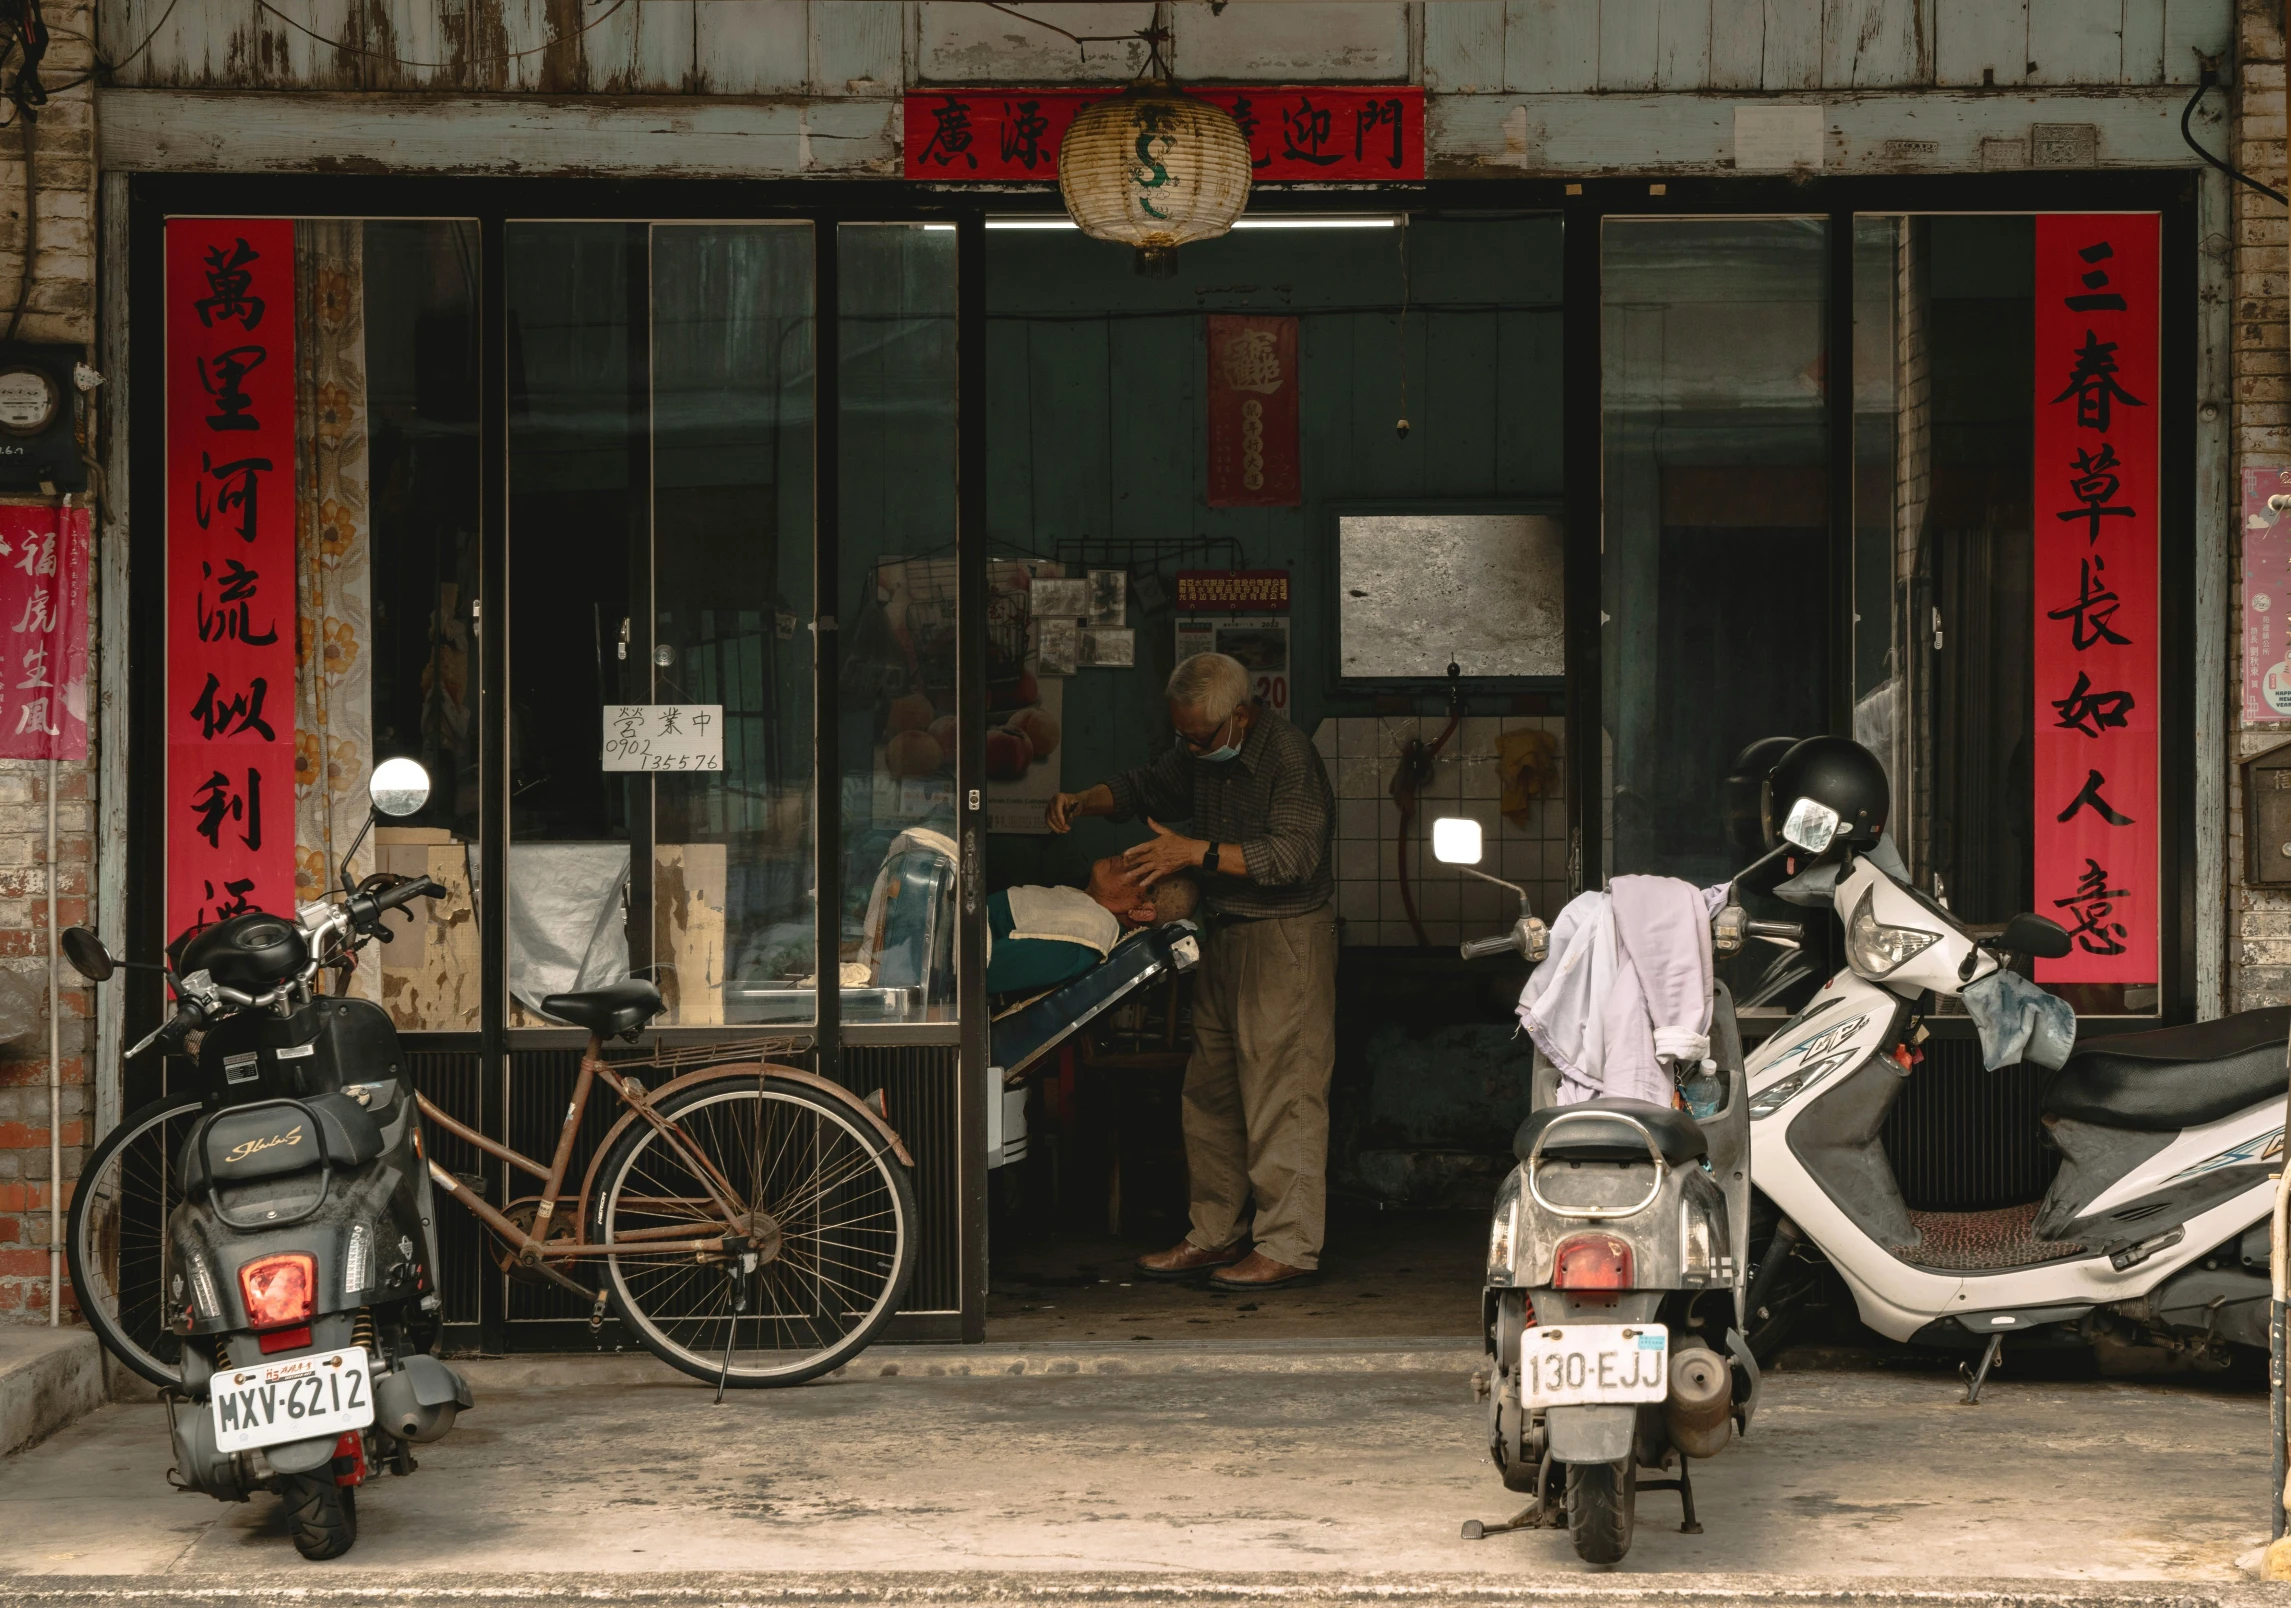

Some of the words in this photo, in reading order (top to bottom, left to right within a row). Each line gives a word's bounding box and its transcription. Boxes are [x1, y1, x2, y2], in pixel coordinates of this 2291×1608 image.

[1244, 401, 1262, 488] 鼠年行大運
[2048, 241, 2147, 957] 三春草長如人意
[13, 530, 59, 736] 福虎生風
[1257, 677, 1286, 709] 20
[613, 706, 711, 739] 營業中
[605, 738, 653, 761] 0902
[641, 754, 719, 771] 135576
[1529, 1351, 1663, 1395] 130-EJJ
[218, 1369, 367, 1433] MXV-6212
